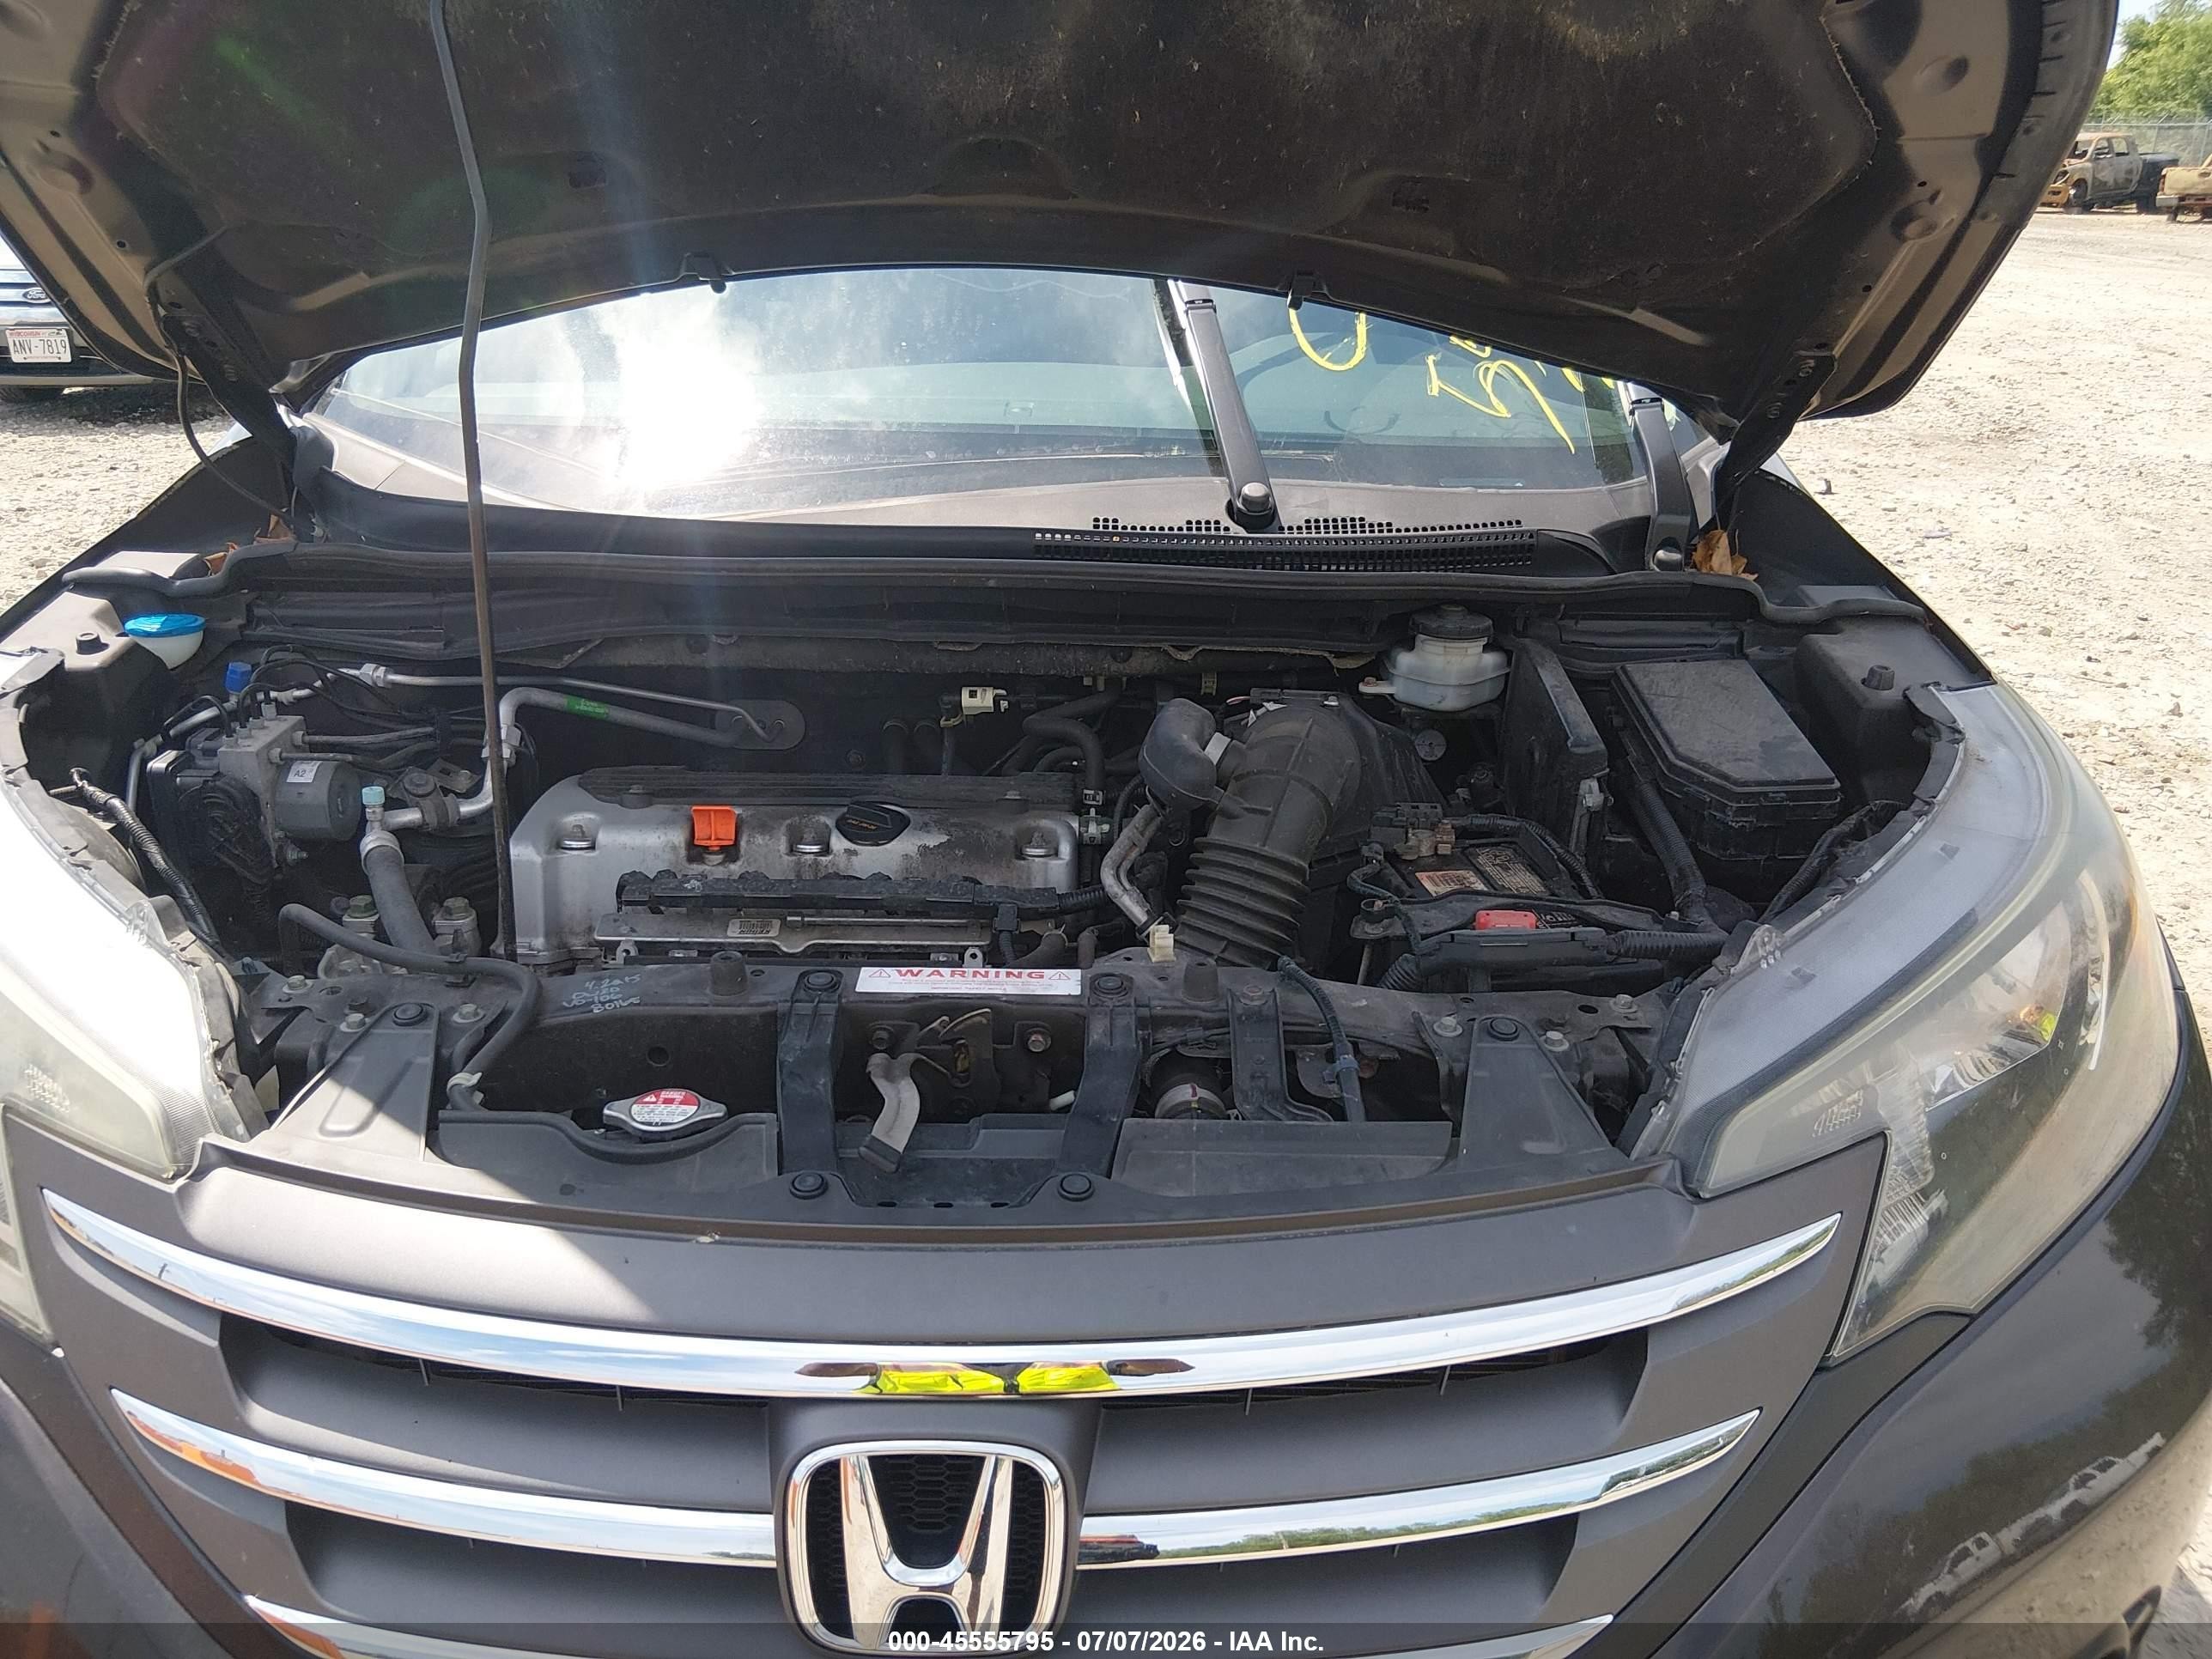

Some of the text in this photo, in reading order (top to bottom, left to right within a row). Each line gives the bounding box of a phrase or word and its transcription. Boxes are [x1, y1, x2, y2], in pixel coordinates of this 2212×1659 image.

[13, 338, 67, 355] ANV-7819
[294, 769, 307, 778] A2
[894, 969, 1045, 980] WARNING
